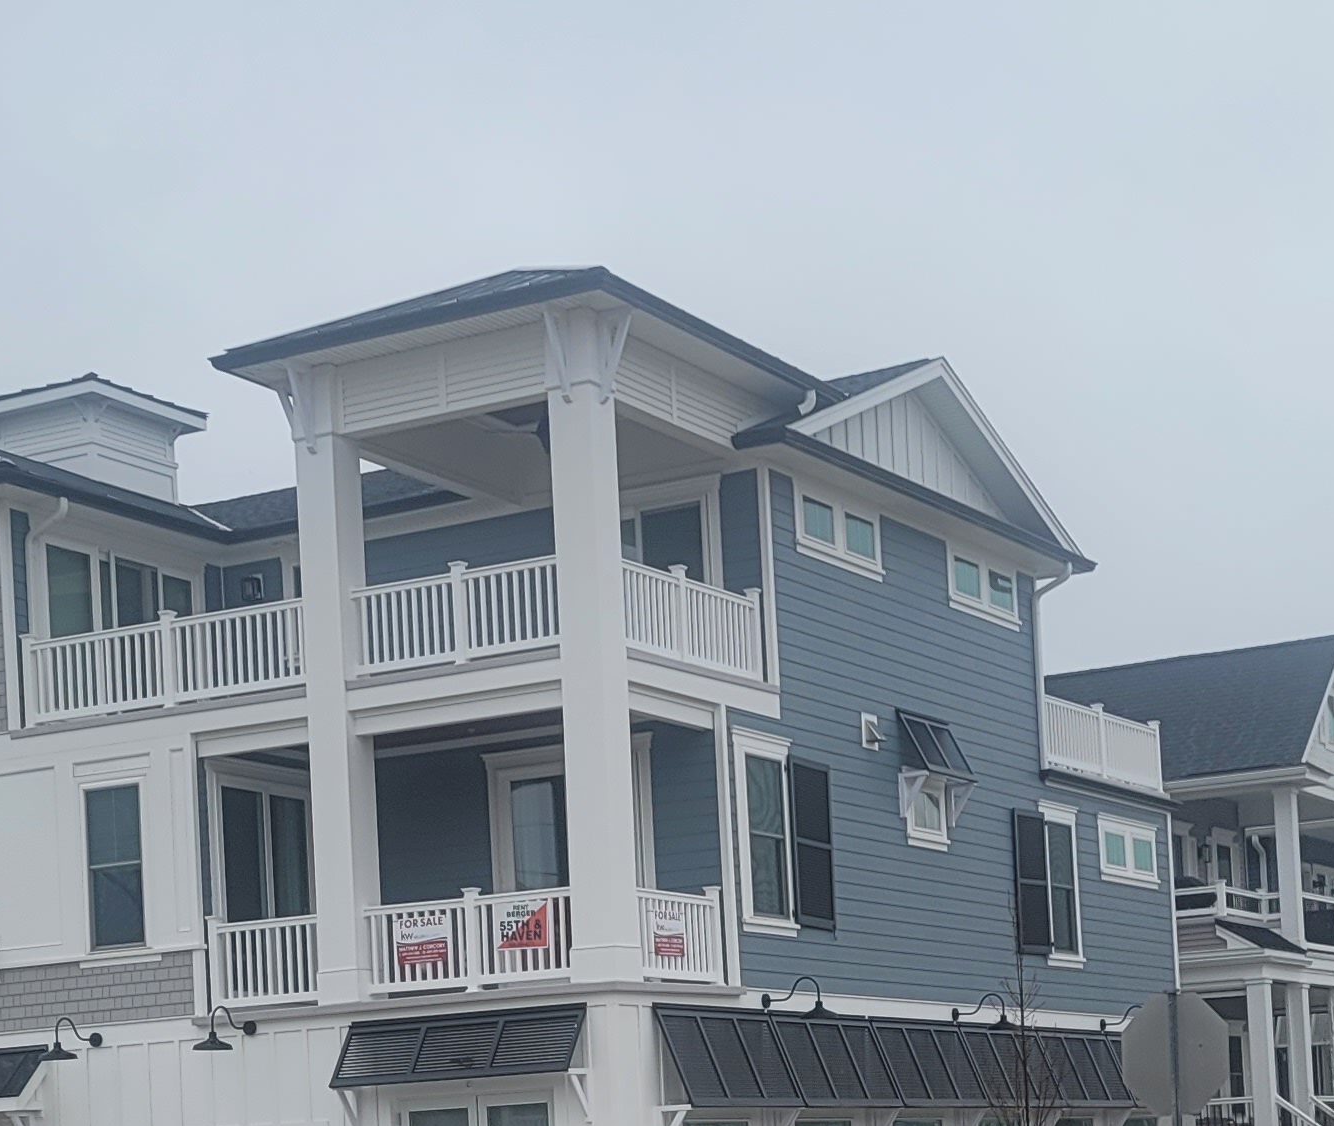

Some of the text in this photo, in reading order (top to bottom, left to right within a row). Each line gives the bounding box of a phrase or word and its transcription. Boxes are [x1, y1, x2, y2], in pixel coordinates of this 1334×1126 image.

[655, 910, 681, 921] FOR SALE
[400, 917, 443, 929] FOR SALE
[500, 919, 541, 932] 55TH &
[400, 930, 413, 941] kw
[501, 930, 542, 942] HAVEN
